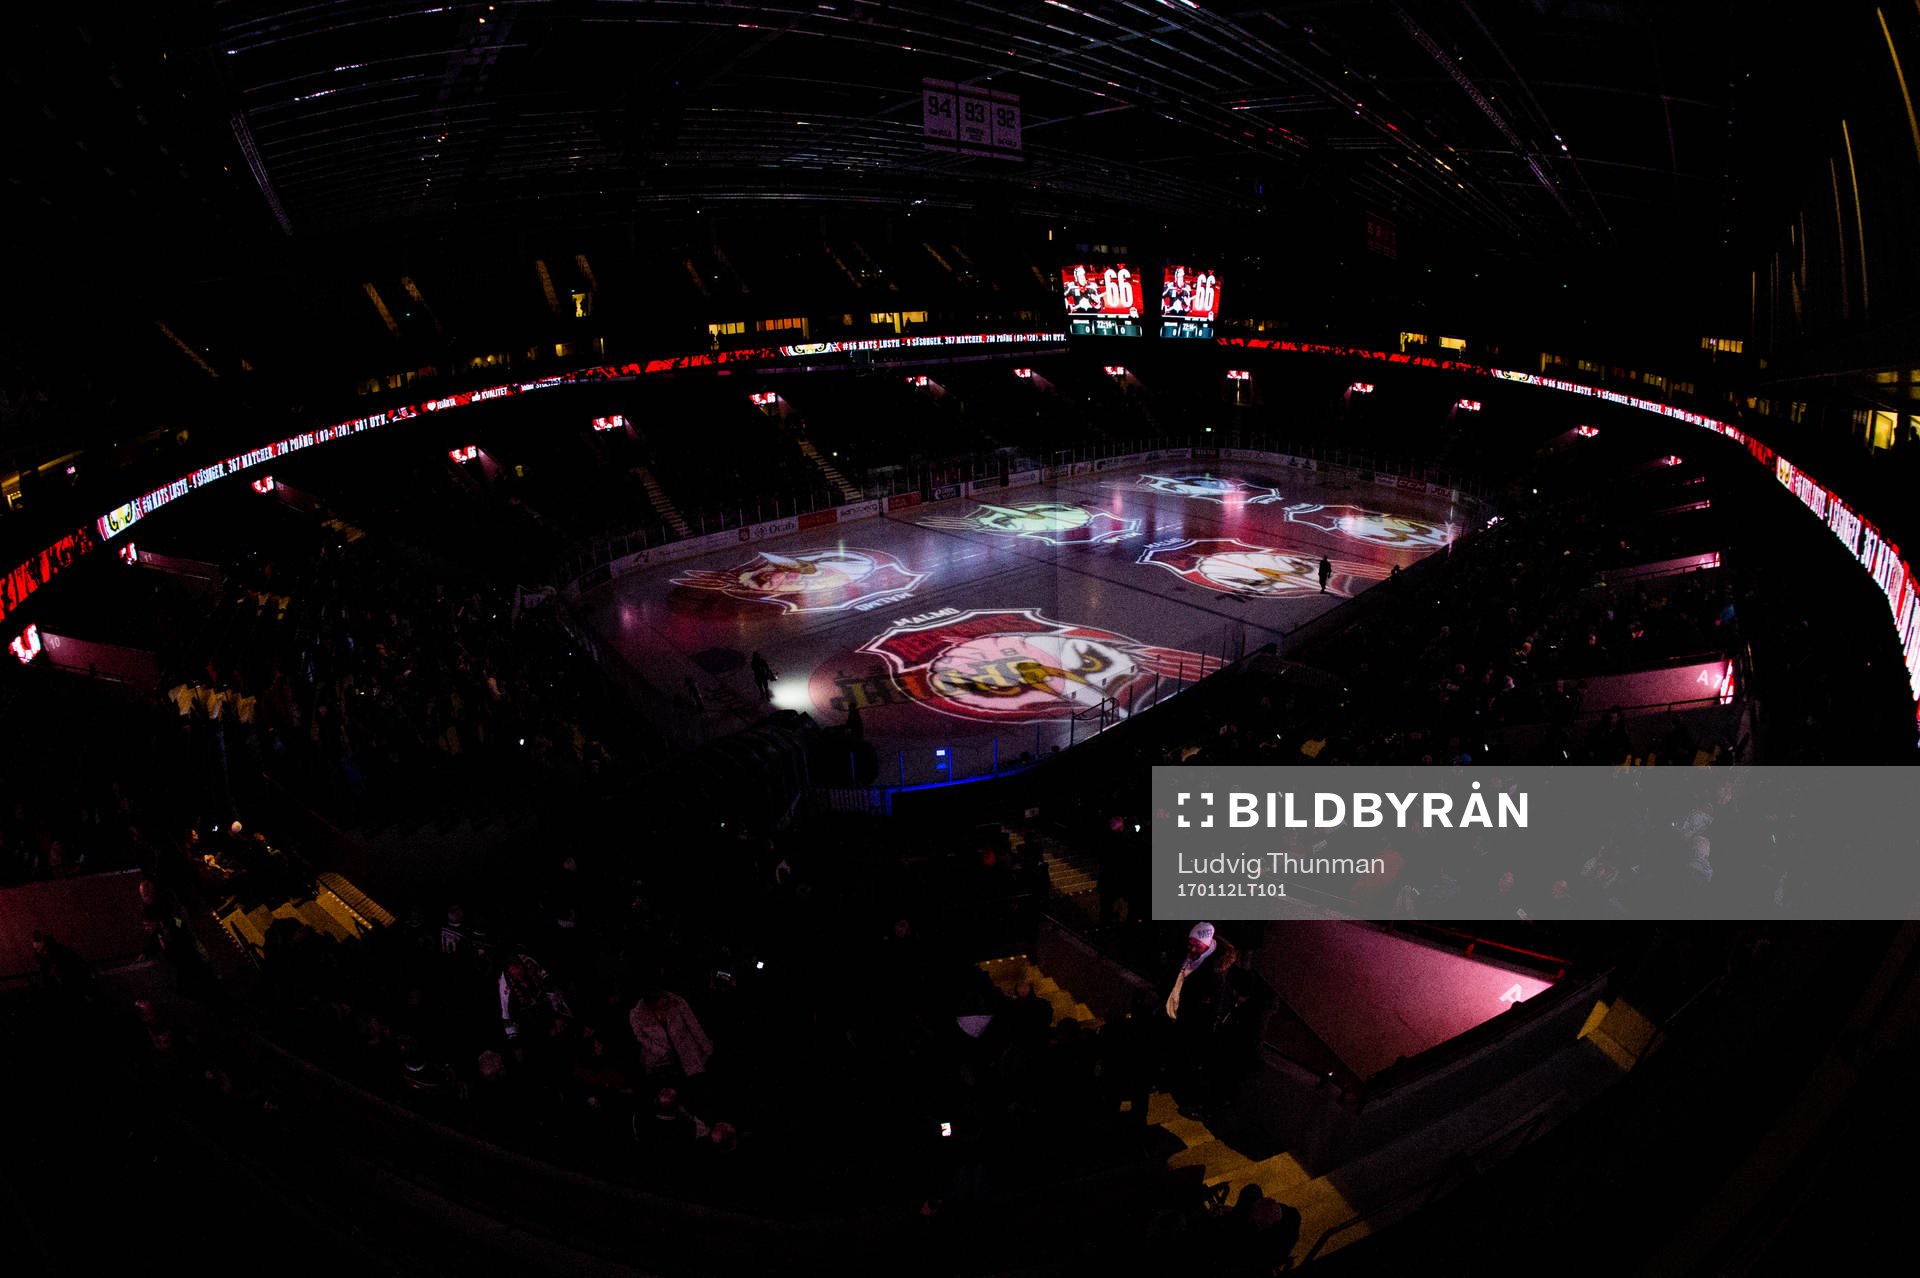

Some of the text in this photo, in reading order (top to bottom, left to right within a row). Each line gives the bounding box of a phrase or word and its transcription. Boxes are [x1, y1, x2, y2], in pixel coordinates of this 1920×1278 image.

[927, 95, 952, 118] 94
[964, 102, 986, 123] 93
[996, 108, 1016, 129] 92
[1104, 269, 1134, 308] 66
[1196, 274, 1216, 311] 66
[481, 387, 508, 400] KVALITET
[1696, 670, 1708, 685] A
